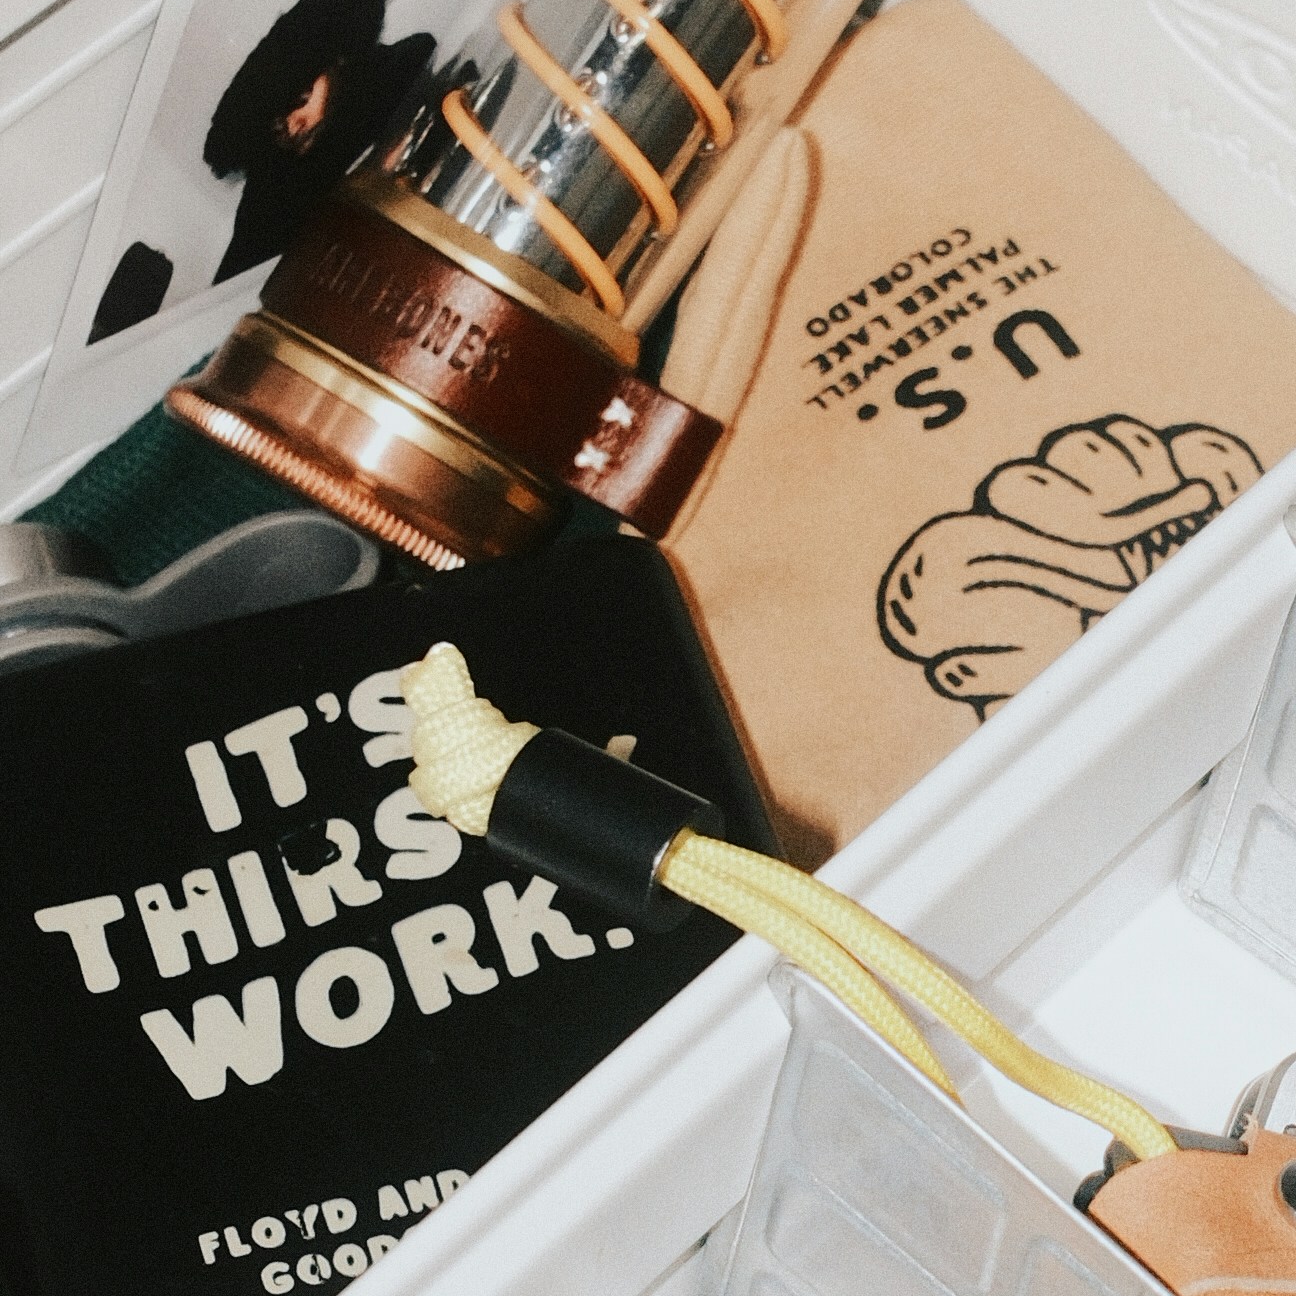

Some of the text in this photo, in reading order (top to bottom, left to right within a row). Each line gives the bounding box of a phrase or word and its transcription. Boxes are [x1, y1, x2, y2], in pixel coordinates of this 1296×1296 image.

[802, 238, 1021, 376] PALMER LAKE
[806, 228, 972, 338] COLORADO
[806, 258, 1062, 410] THE SNEERWELL
[856, 309, 1081, 431] U.S.
[185, 661, 420, 834] IT'S
[34, 735, 637, 994] THIRS
[140, 875, 635, 1101] WORK.
[198, 1198, 358, 1265] FLOYD
[260, 1230, 404, 1296] GOOD
